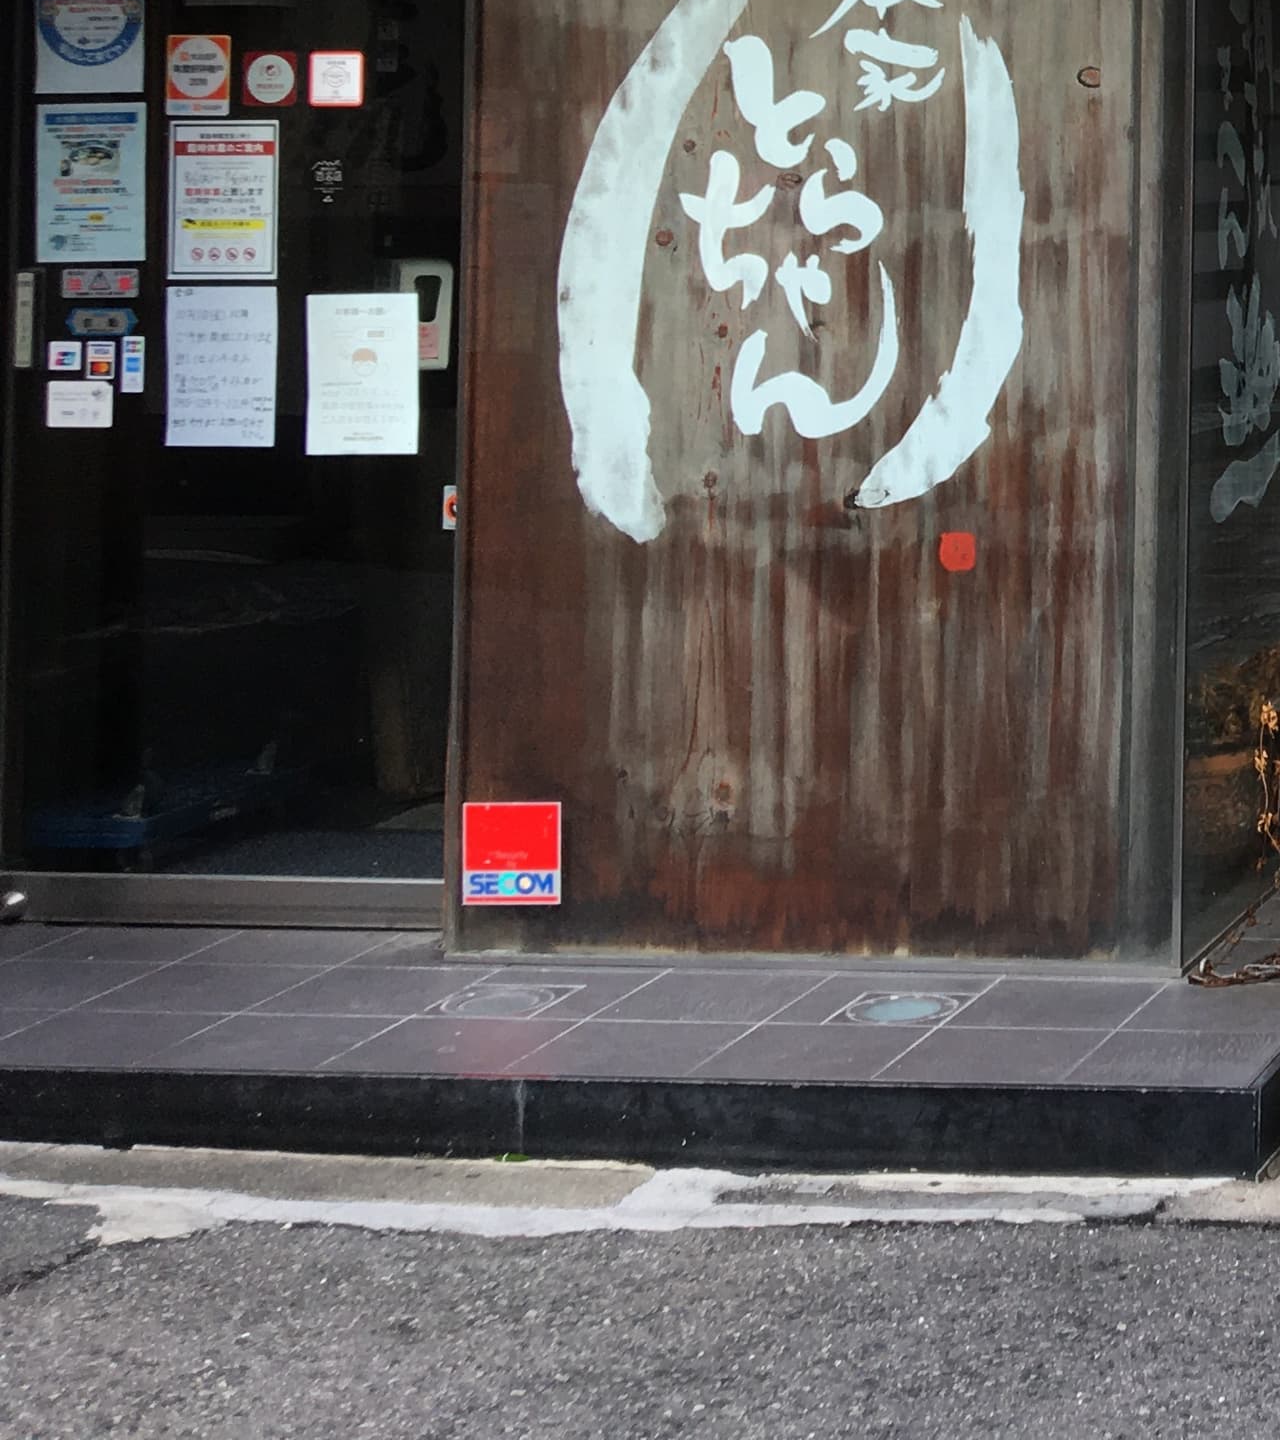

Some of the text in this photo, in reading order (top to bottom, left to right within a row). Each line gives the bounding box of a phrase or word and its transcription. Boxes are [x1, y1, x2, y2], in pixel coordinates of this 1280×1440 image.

[678, 34, 900, 439] とらちゃん
[469, 871, 554, 896] SECOM
